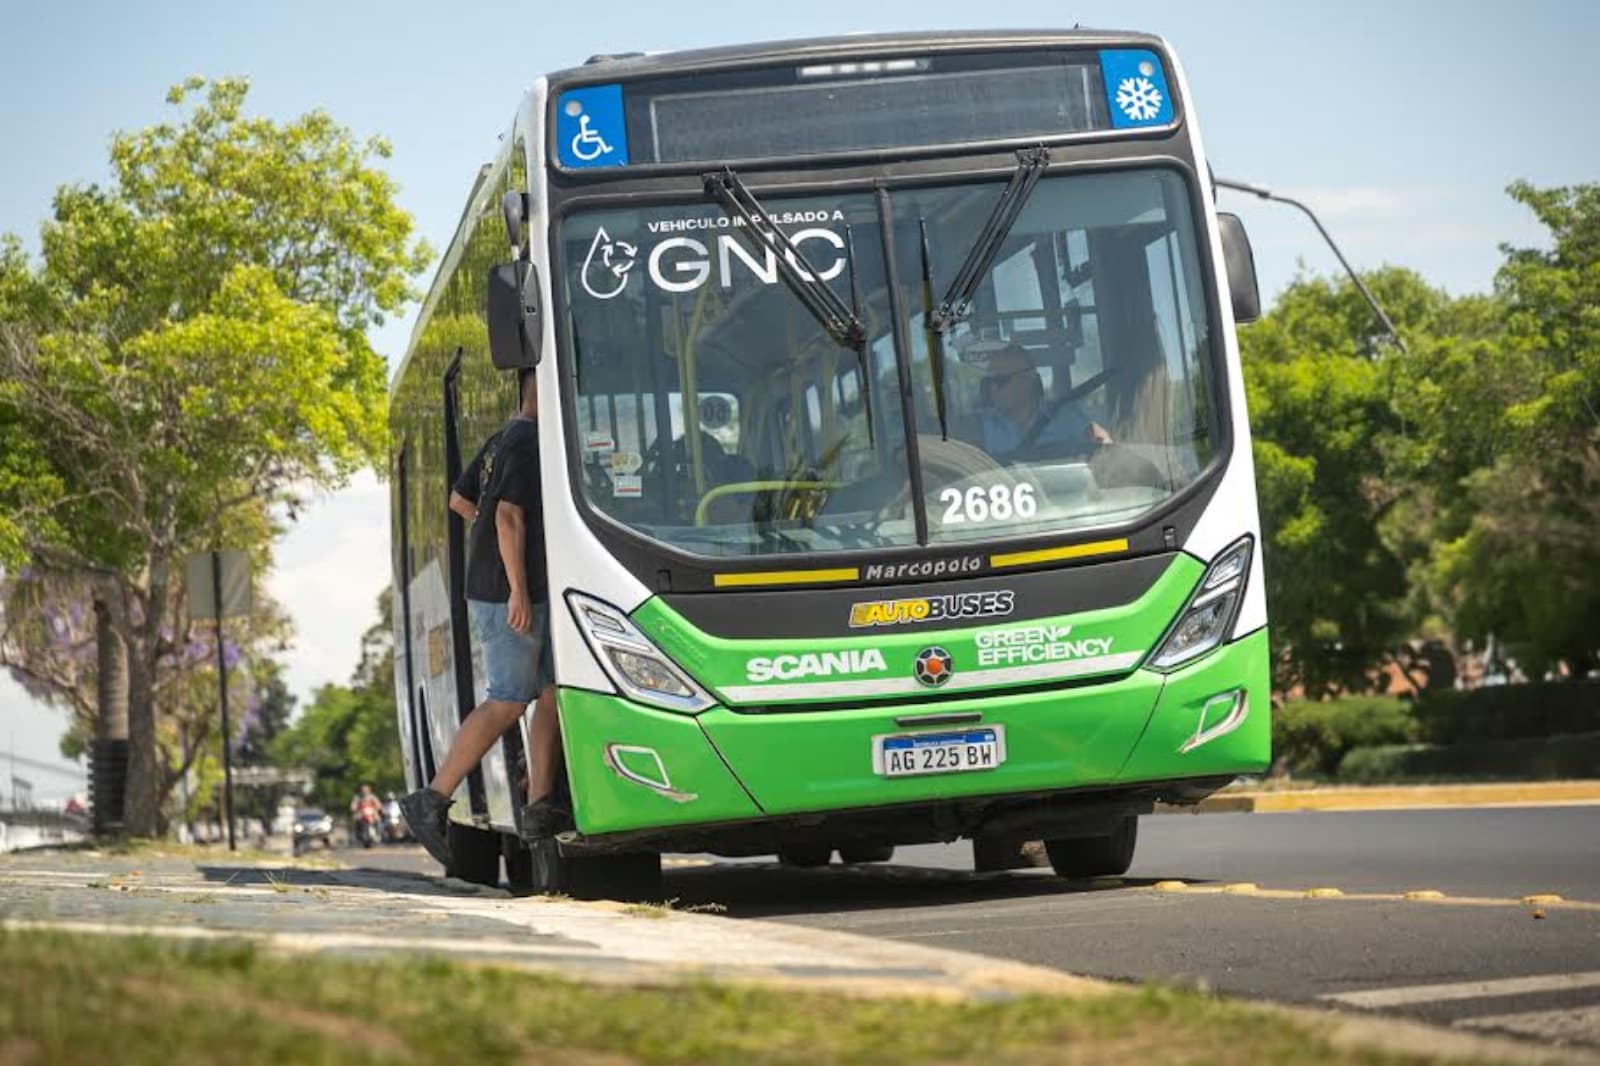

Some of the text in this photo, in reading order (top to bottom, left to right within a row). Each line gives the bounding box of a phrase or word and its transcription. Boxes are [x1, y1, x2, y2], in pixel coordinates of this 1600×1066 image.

[647, 216, 730, 233] VEHICULO
[832, 209, 844, 221] A
[648, 228, 847, 293] GNC
[940, 482, 1037, 524] 2686
[865, 556, 981, 581] Marcopolo
[850, 590, 1014, 628] AUTOBUSES
[975, 624, 1059, 648] GREEN
[746, 648, 888, 682] SCANIA
[977, 637, 1114, 666] EFFICIENCY
[890, 744, 992, 772] AG 225 BW
